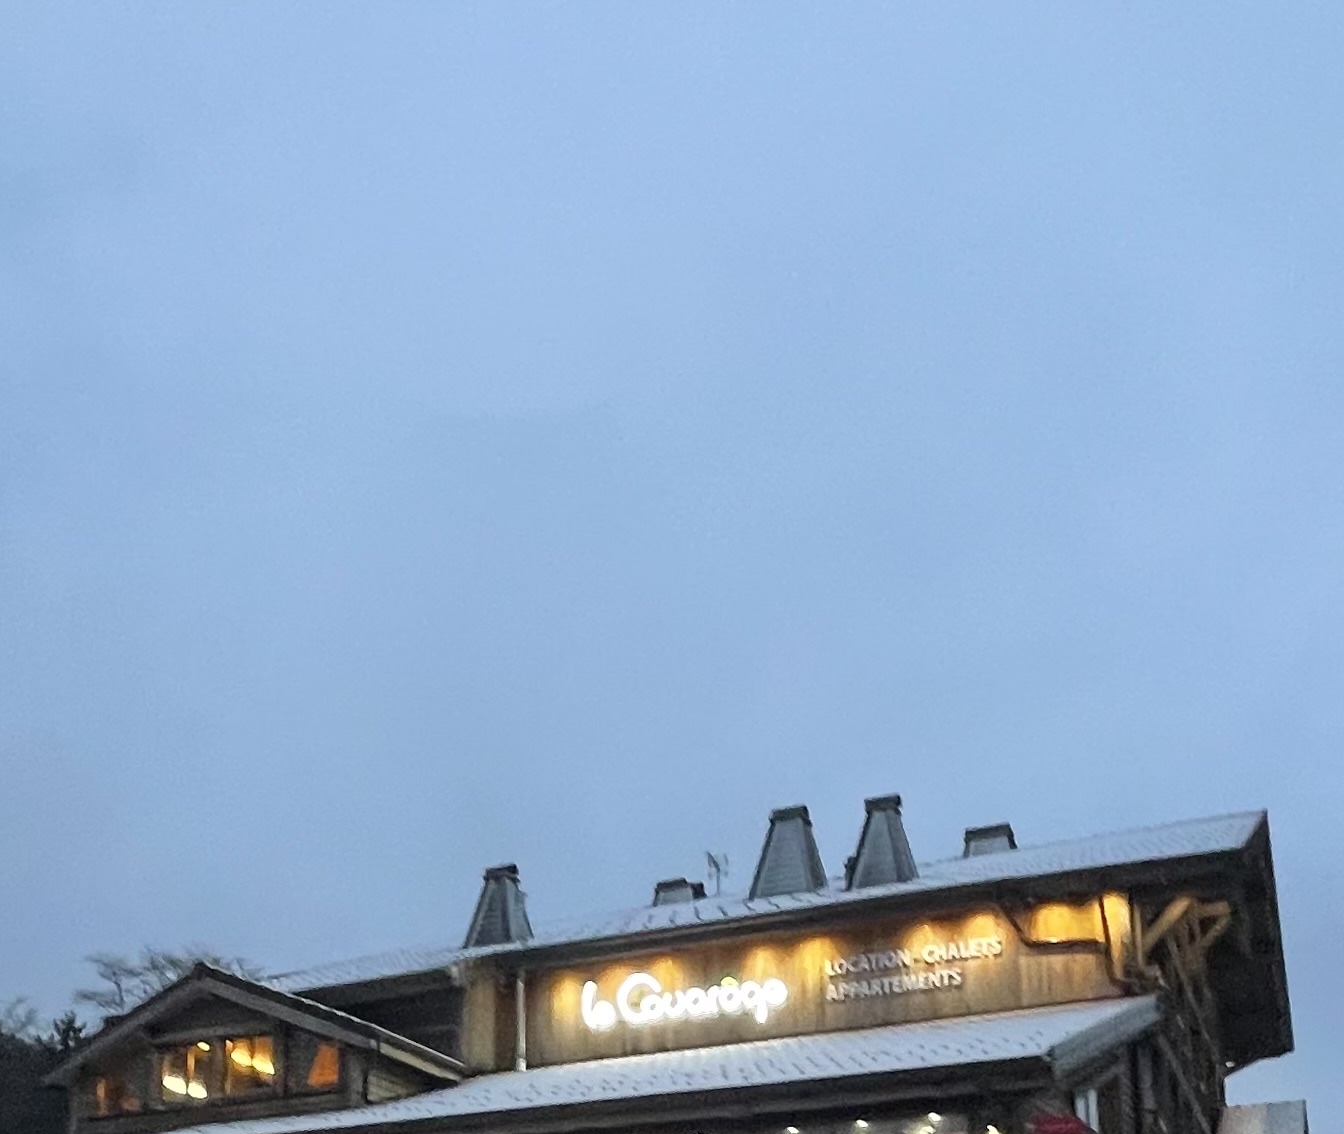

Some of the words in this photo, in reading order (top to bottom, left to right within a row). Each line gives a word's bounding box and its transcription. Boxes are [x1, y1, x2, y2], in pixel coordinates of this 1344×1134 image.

[824, 947, 912, 977] LOCATION
[921, 936, 1003, 965] CHALETS
[825, 967, 964, 1002] APPARTEMENTS
